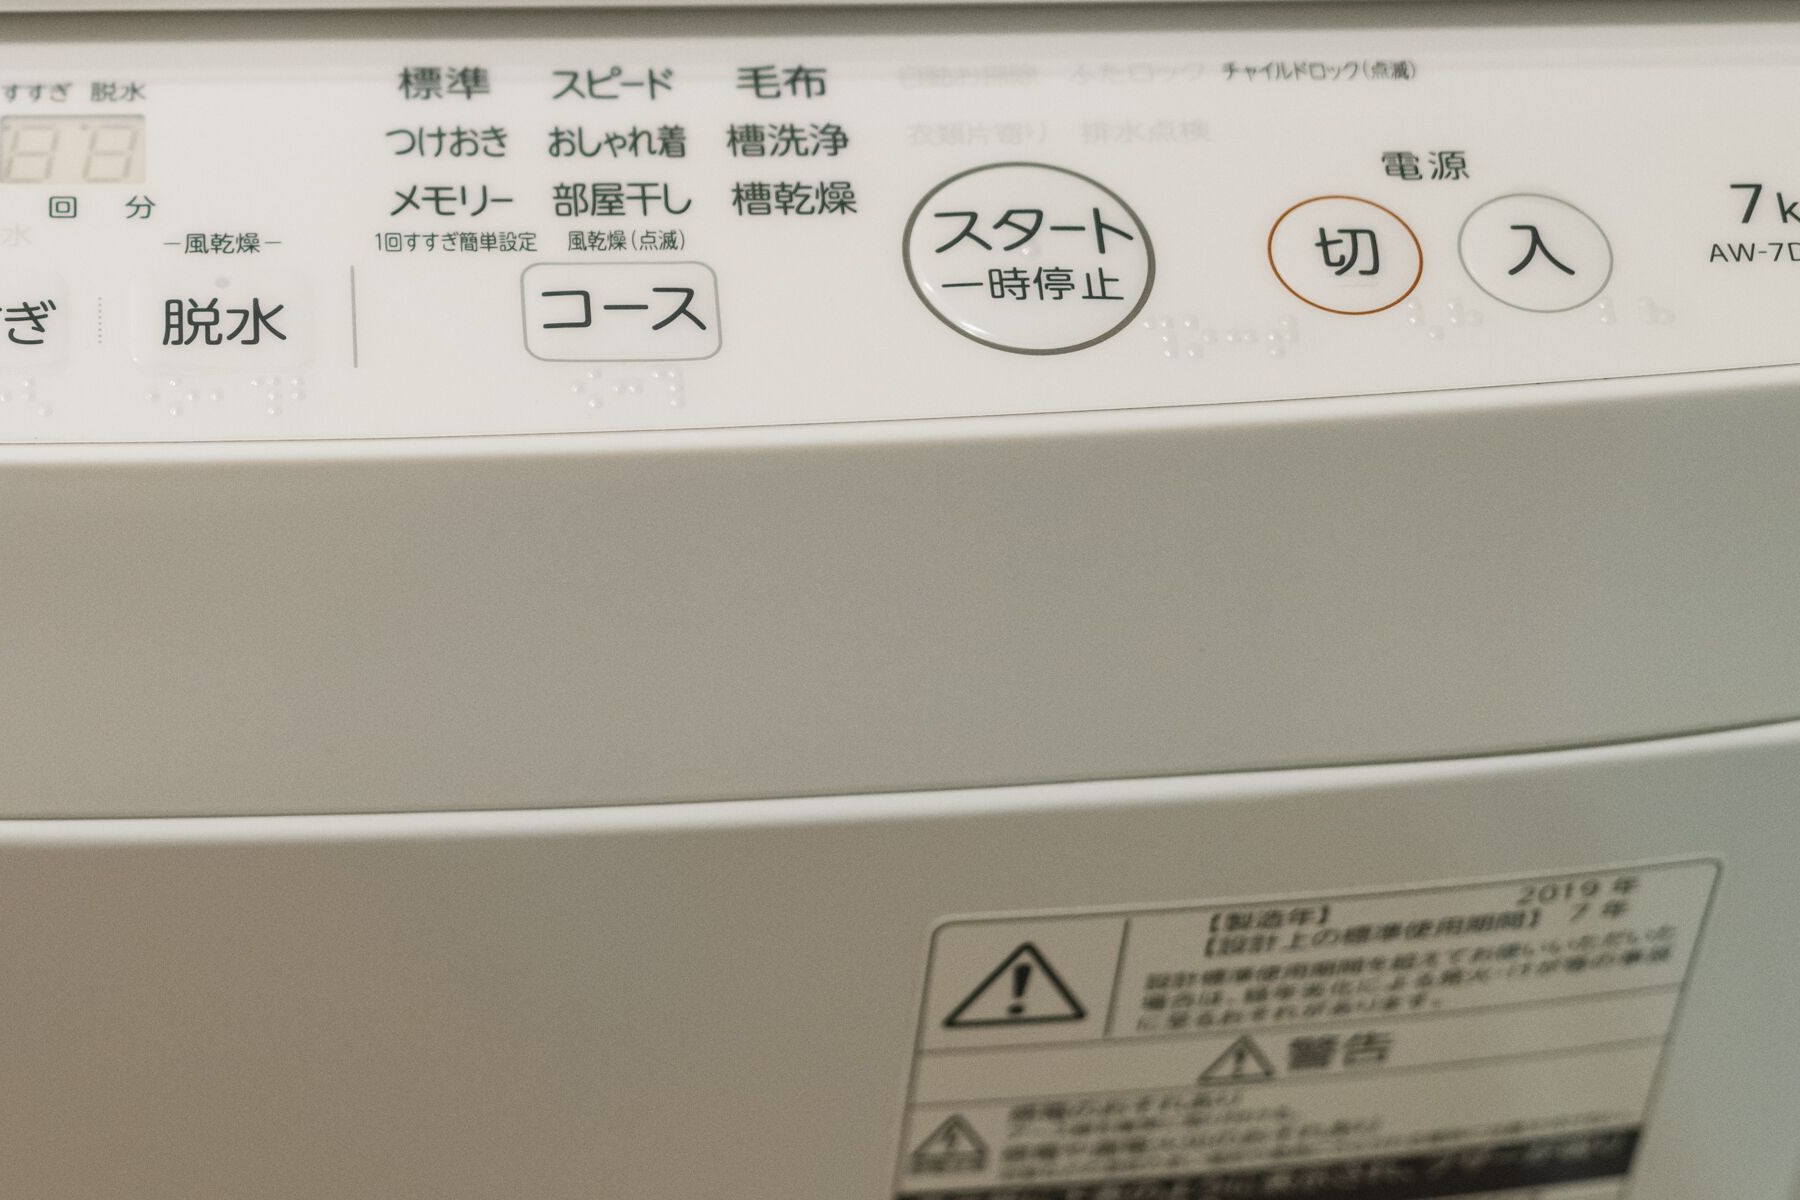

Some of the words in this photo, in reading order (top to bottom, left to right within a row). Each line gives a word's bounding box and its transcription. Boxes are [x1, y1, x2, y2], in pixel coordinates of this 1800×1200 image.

[2, 81, 73, 103] すすぎ
[90, 81, 145, 103] 脱水
[398, 66, 490, 101] 標準
[552, 65, 674, 101] スピード
[737, 64, 827, 100] 毛布
[385, 125, 508, 158] つけおき
[548, 124, 687, 159] おしゃれ着
[726, 122, 850, 158] 槽洗浄
[1381, 150, 1470, 181] 電源
[48, 195, 78, 219] 回
[125, 195, 156, 220] 分
[390, 184, 514, 217] メモリー
[552, 182, 692, 218] 部屋干し
[731, 180, 858, 217] 槽乾燥
[375, 231, 538, 253] 1回すすぎ簡単設定
[933, 205, 1137, 255] スタート
[1314, 227, 1380, 277] 切
[1507, 224, 1576, 276] 入
[941, 266, 1125, 301] 一時停止
[162, 297, 287, 346] 脱水
[541, 287, 707, 331] コース
[1514, 878, 1603, 906] 2019
[1567, 901, 1592, 923] 7
[1283, 1030, 1396, 1072] 警告
